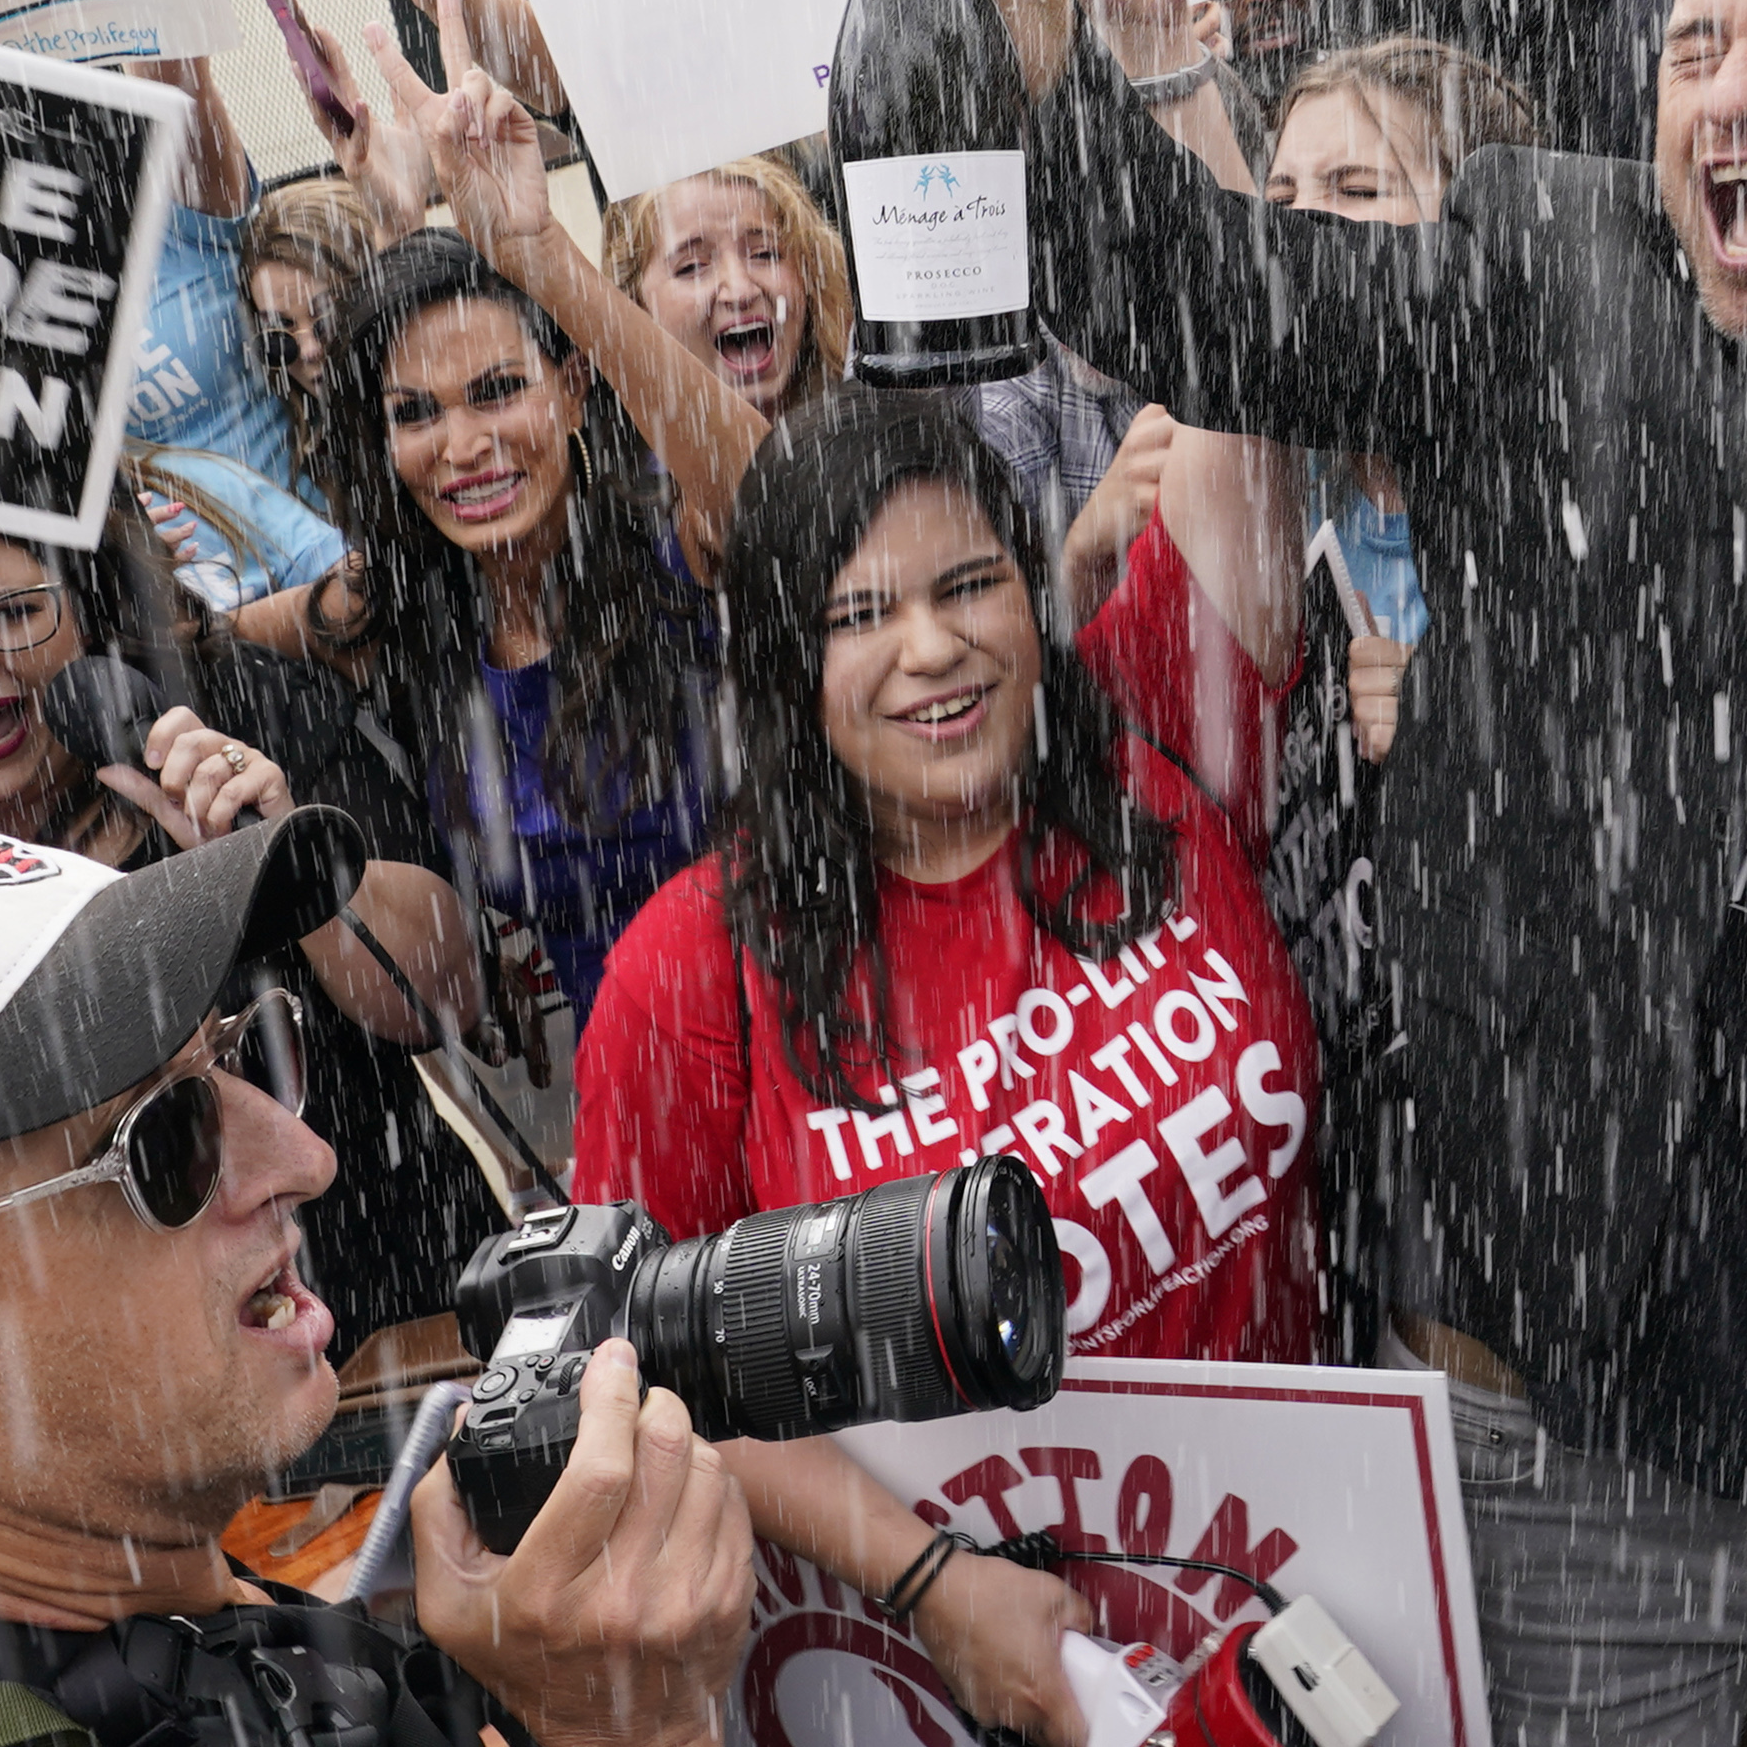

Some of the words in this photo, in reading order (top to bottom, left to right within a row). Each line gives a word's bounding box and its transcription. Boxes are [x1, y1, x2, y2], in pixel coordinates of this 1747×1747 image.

[872, 204, 948, 232] Ménage
[953, 205, 965, 222] à
[966, 195, 1006, 220] Trois
[906, 266, 982, 281] PROSECCO
[806, 1065, 960, 1181] THE
[957, 913, 1199, 1113] PRO-LI
[612, 1226, 641, 1271] Canon
[713, 1280, 725, 1295] 50
[807, 1262, 822, 1325] 24-70mm
[715, 1328, 726, 1343] 70
